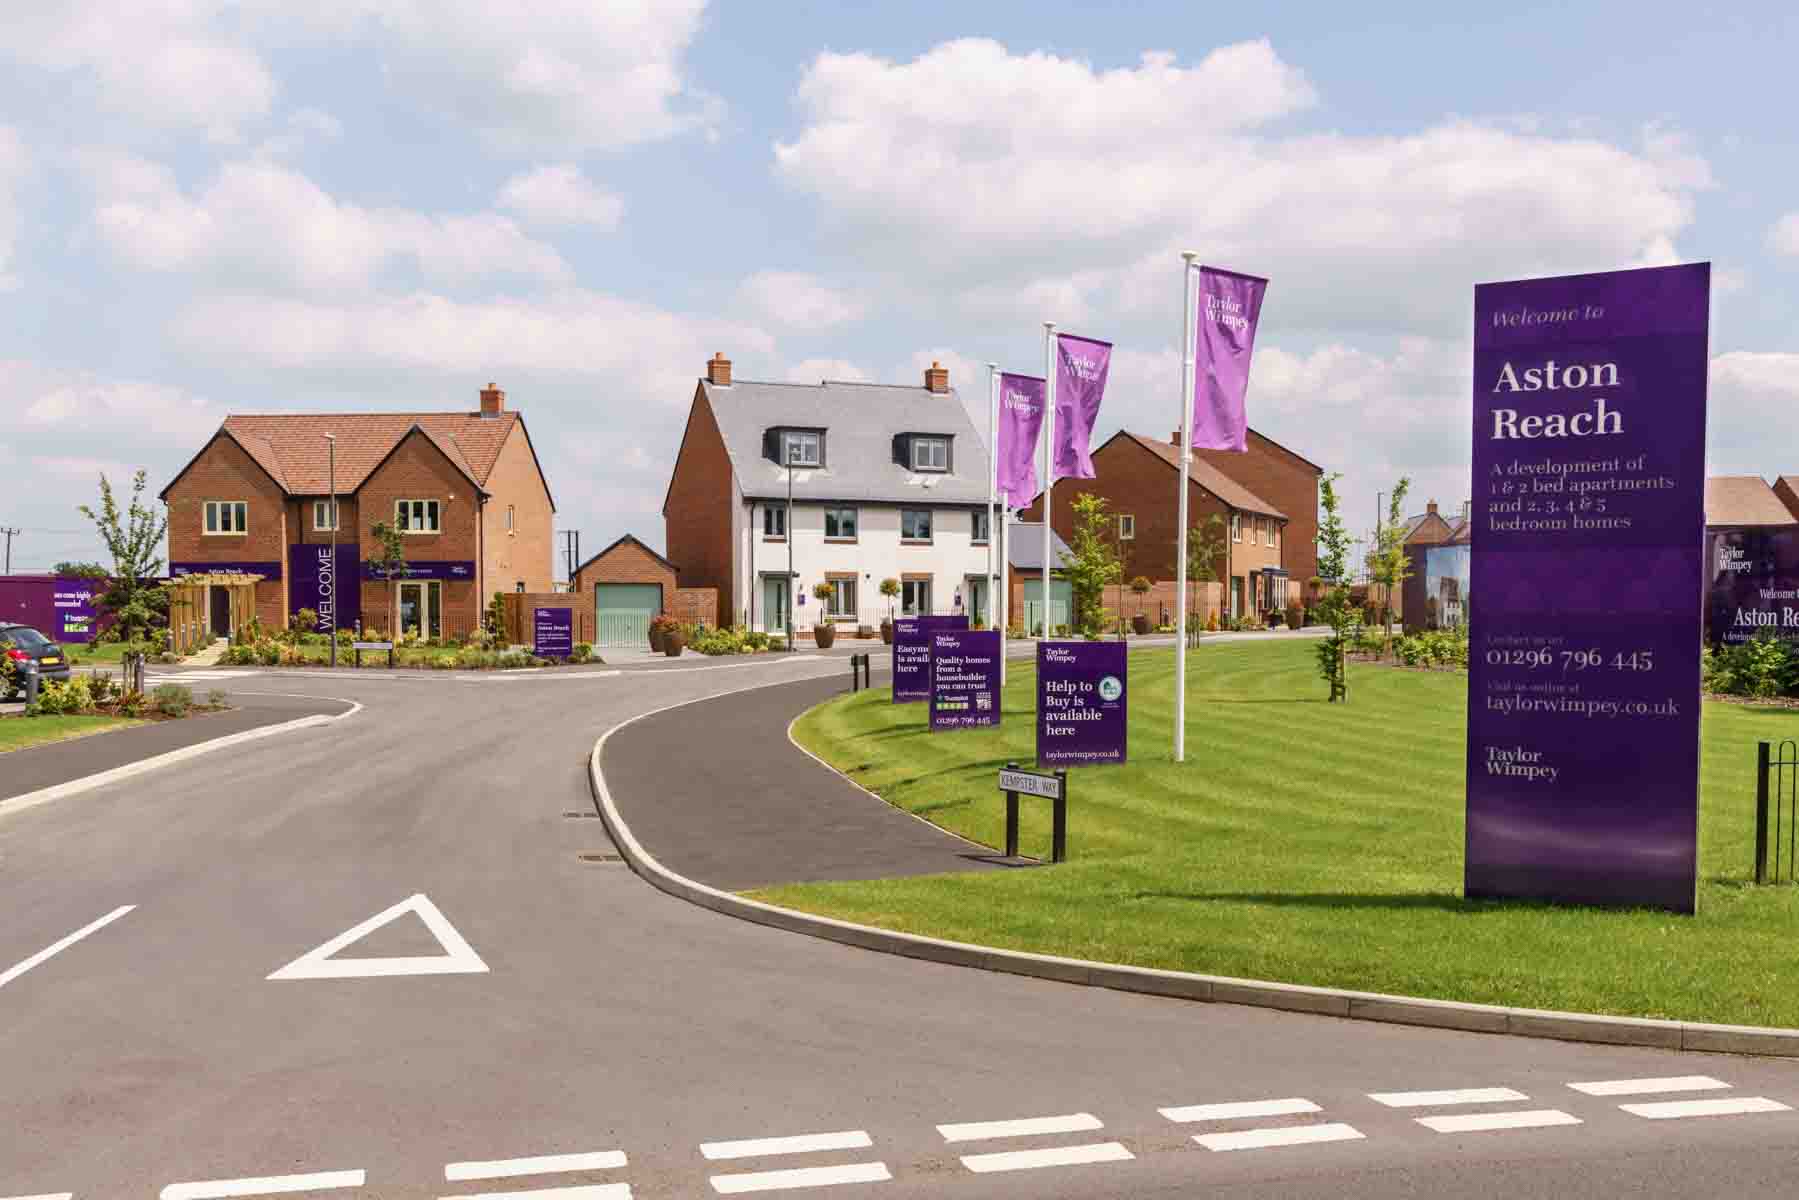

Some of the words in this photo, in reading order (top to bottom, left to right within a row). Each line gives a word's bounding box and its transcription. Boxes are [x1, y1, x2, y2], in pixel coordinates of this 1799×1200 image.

[1205, 294, 1241, 312] Taylor
[1492, 307, 1578, 328] Welcome
[1584, 305, 1605, 319] to
[1492, 360, 1621, 392] Aston
[1490, 399, 1624, 440] Reach
[1490, 463, 1502, 477] A
[1507, 457, 1620, 477] development
[1626, 453, 1647, 471] of
[1502, 481, 1514, 494] &
[1519, 484, 1528, 494] 2
[1533, 478, 1564, 493] bed
[1569, 476, 1676, 495] apartments
[1489, 498, 1521, 513] and
[1565, 500, 1574, 513] 4
[1580, 497, 1592, 510] &
[1596, 499, 1606, 513] 5
[1489, 515, 1567, 531] bedroom
[1573, 514, 1632, 529] homes
[1720, 545, 1744, 560] Taylor
[1720, 559, 1752, 573] Wimpey
[318, 548, 332, 631] WELCOME
[1760, 587, 1795, 599] Welcome
[1734, 607, 1777, 627] Aston
[1046, 647, 1070, 656] Taylor
[1046, 654, 1077, 664] Wimpey
[1486, 646, 1553, 669] 01296
[1560, 648, 1602, 671] 796
[1608, 650, 1653, 671] 445
[897, 663, 919, 673] here
[936, 656, 964, 665] Quality
[965, 656, 992, 664] homes
[936, 665, 956, 673] from
[936, 672, 987, 681] housebuilder
[936, 683, 951, 691] you
[967, 682, 986, 690] trust
[1046, 680, 1077, 695] Help
[1080, 681, 1093, 693] to
[1046, 696, 1073, 710] Buy
[1074, 696, 1084, 707] is
[1487, 694, 1680, 718] taylorwimpey.co.uk
[1046, 708, 1103, 721] available
[1046, 723, 1076, 736] here
[1046, 749, 1120, 762] taylorwimpey.co.uk
[1486, 746, 1543, 765] Taylor
[1486, 761, 1560, 782] Wimpey
[1001, 774, 1038, 792] KEMPSTER
[1042, 781, 1057, 793] WAY
